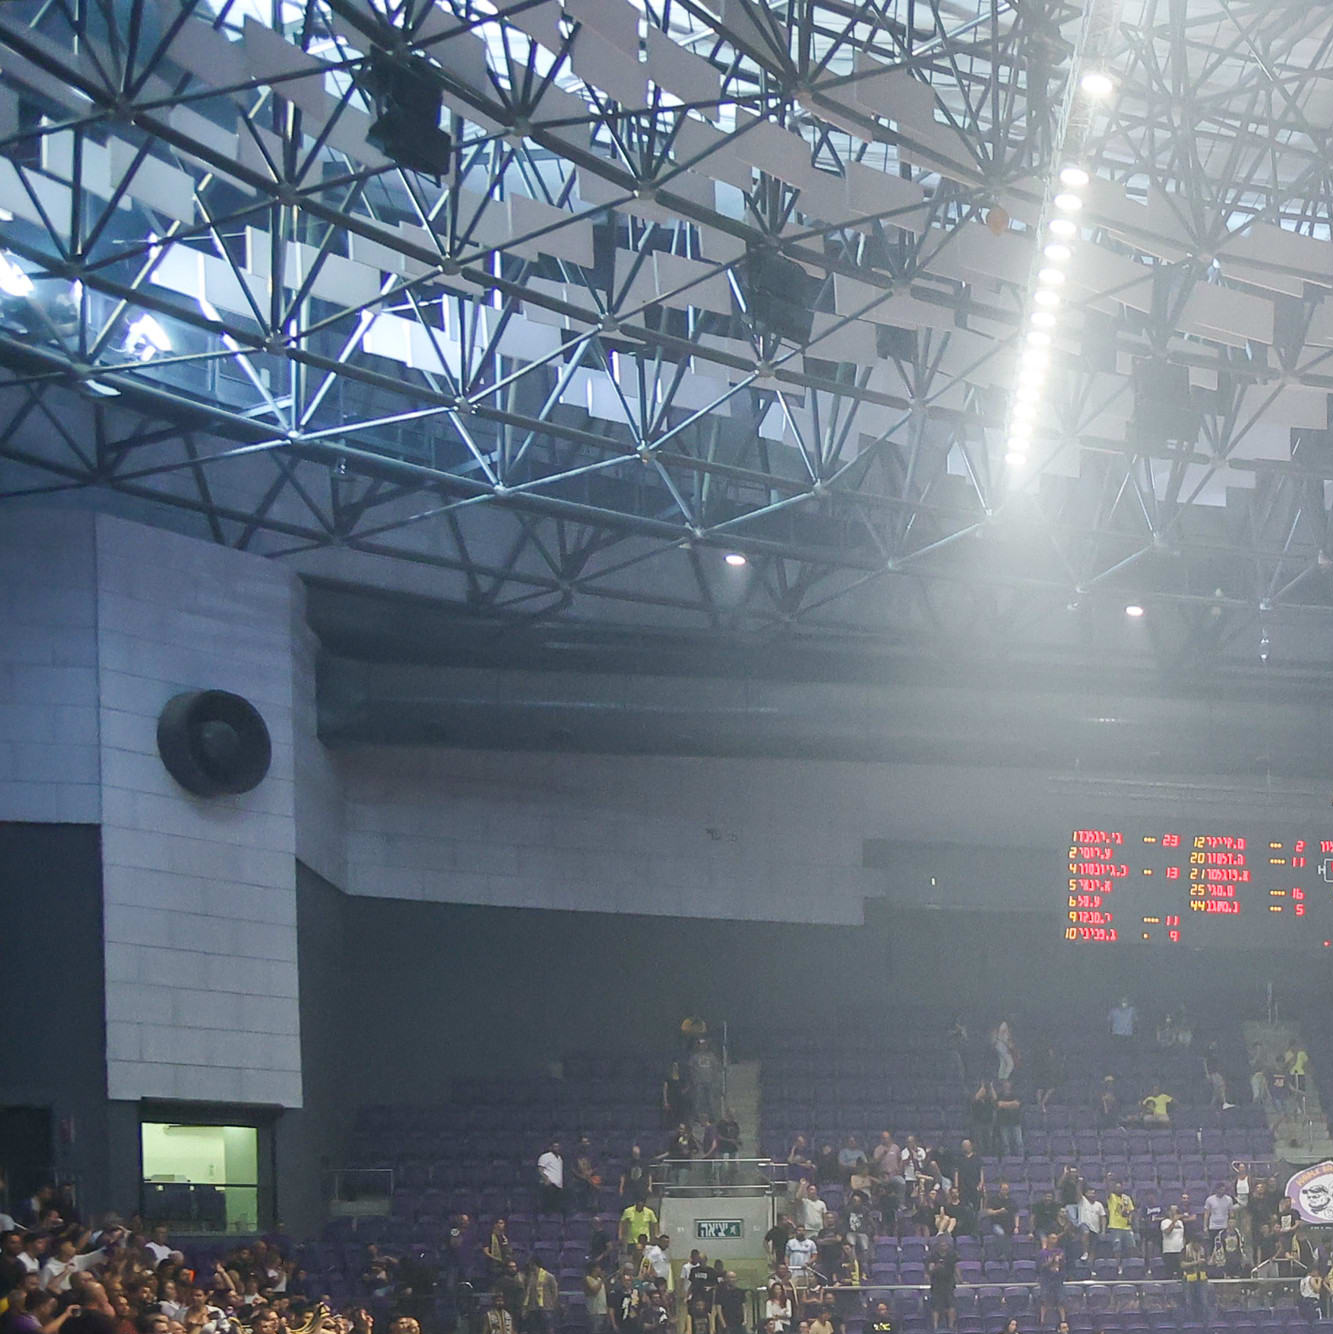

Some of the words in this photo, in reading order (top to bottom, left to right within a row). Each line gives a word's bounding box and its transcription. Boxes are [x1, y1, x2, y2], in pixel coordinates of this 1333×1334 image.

[1162, 834, 1180, 847] 23
[1190, 852, 1205, 864] 20
[1166, 867, 1180, 879] 13
[1190, 884, 1205, 895] 25
[1190, 900, 1205, 911] 44
[1065, 927, 1077, 940] 10
[700, 1222, 729, 1238] יציאה
